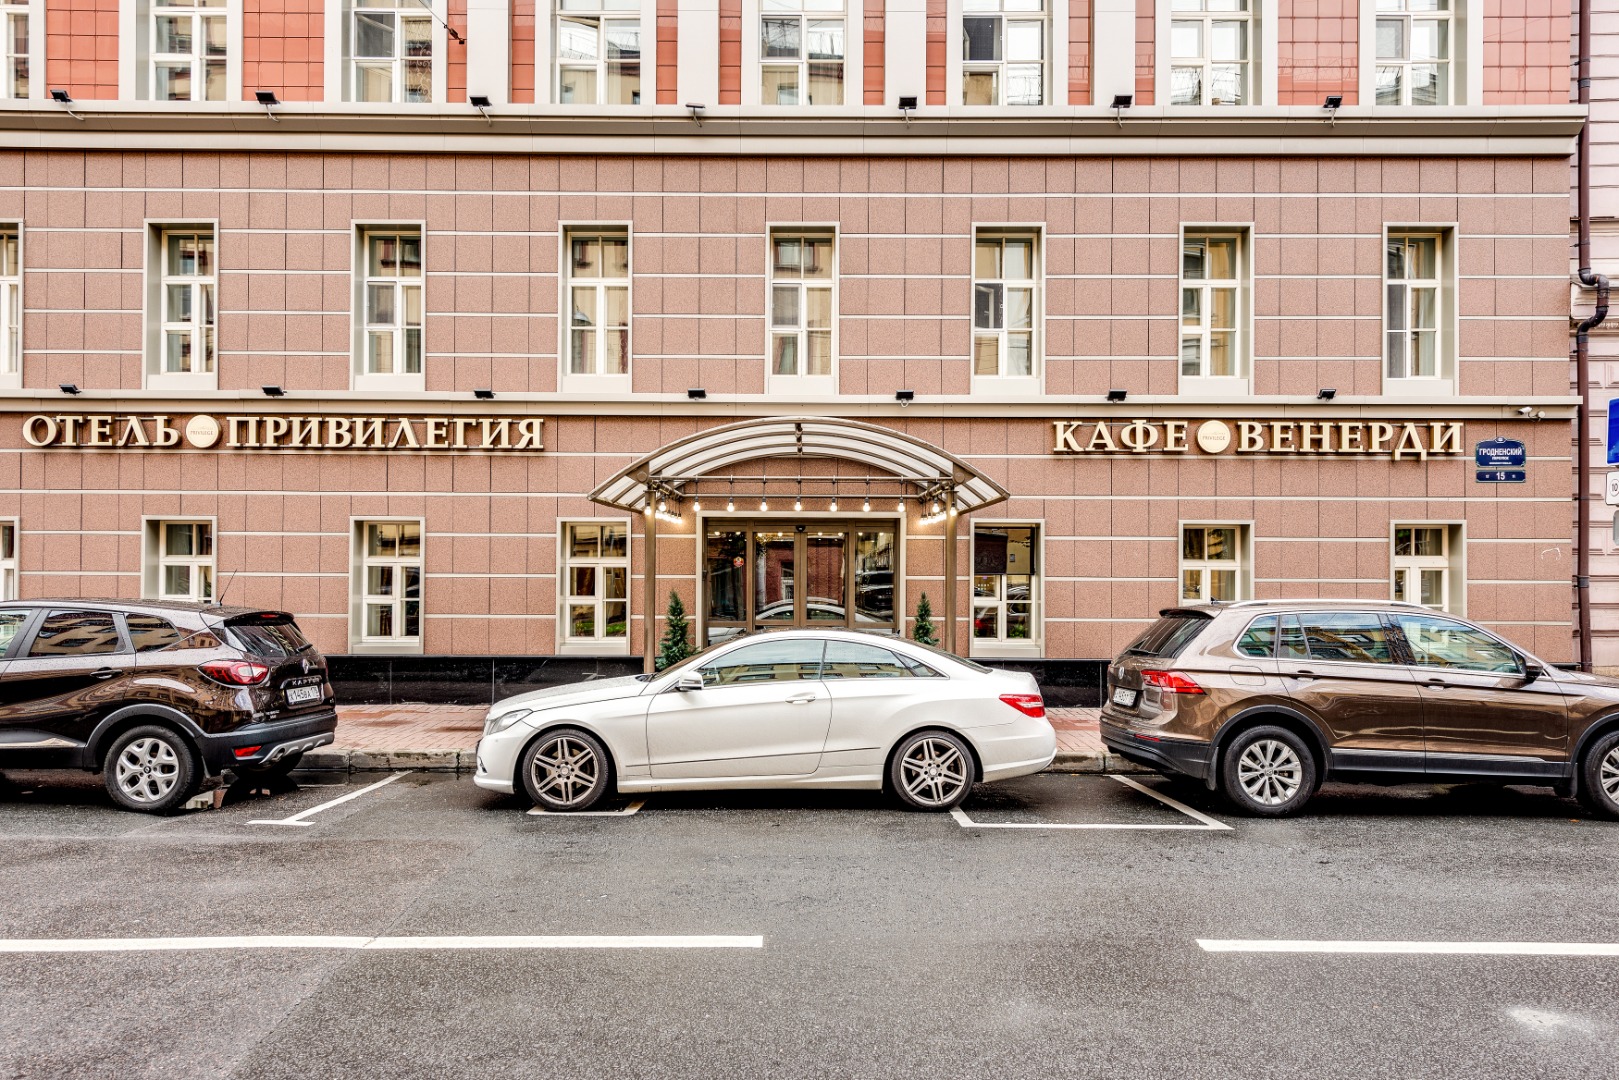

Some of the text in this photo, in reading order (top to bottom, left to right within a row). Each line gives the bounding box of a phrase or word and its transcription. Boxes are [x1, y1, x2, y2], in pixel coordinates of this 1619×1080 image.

[22, 414, 545, 450] ОТЕЛЬ ПРИВИЛЕГИЯ
[1053, 419, 1464, 461] КАФЕ ВЕНЕРДИ
[1479, 447, 1522, 456] ГРОДНЕНСКИЙ
[1497, 472, 1505, 480] 15
